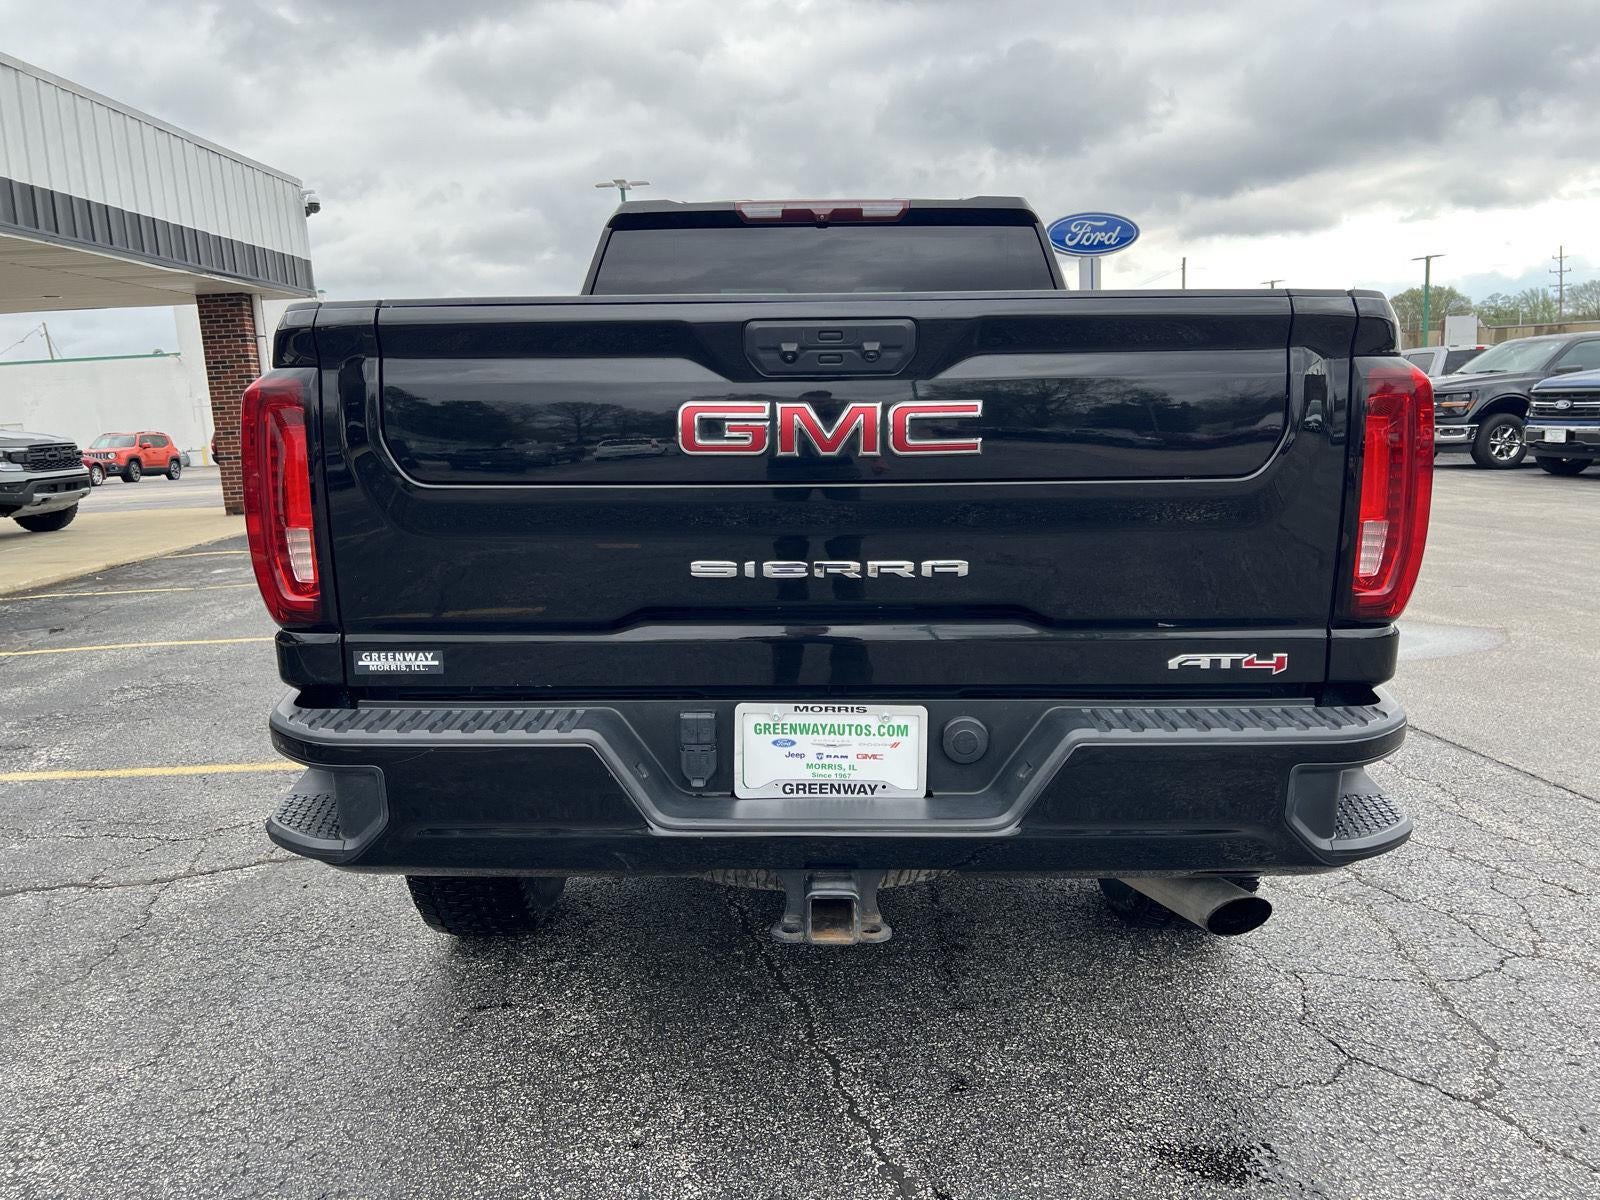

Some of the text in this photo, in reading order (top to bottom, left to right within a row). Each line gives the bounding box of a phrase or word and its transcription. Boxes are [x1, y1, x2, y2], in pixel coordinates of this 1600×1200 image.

[1065, 220, 1121, 246] Ford
[678, 400, 983, 456] GMC
[690, 560, 969, 578] SIERRA
[361, 652, 434, 661] GREENWAY
[1168, 653, 1288, 676] AT4
[794, 705, 868, 714] MORRIS
[754, 723, 909, 737] GREENWAYAUTOS.COM
[785, 751, 805, 760] Jeep
[806, 763, 846, 771] MORRIS,
[782, 783, 878, 795] GREENWAY
